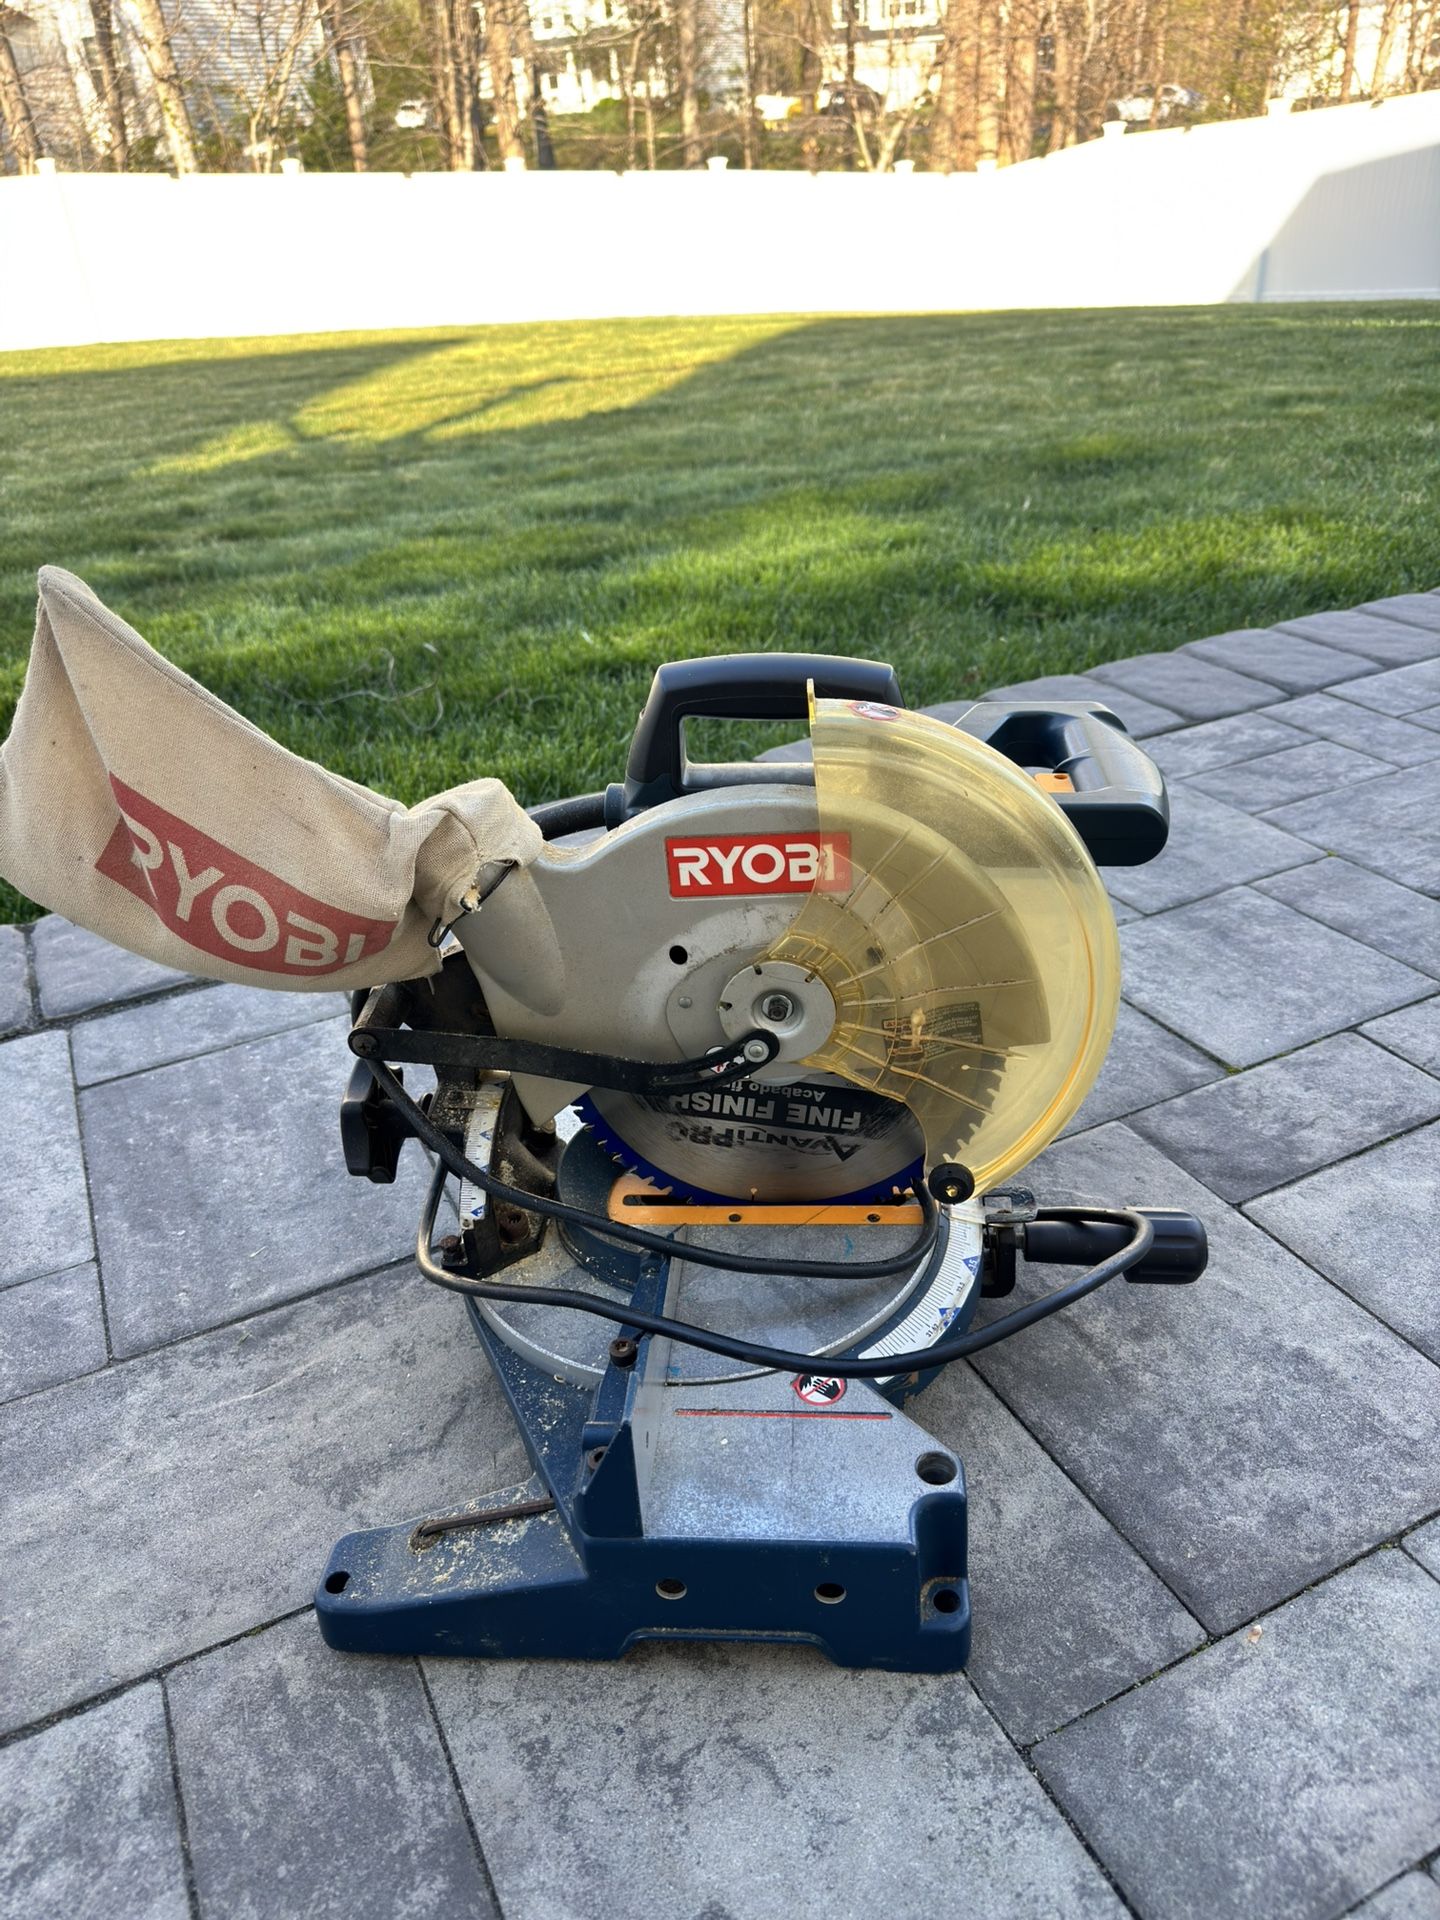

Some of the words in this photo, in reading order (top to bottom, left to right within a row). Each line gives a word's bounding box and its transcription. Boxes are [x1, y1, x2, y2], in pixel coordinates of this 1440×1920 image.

[672, 843, 835, 887] RYOBI
[119, 807, 366, 967] RYOBI
[669, 1091, 776, 1121] FINISH
[748, 1082, 826, 1103] Acabado
[786, 1102, 862, 1130] FINE
